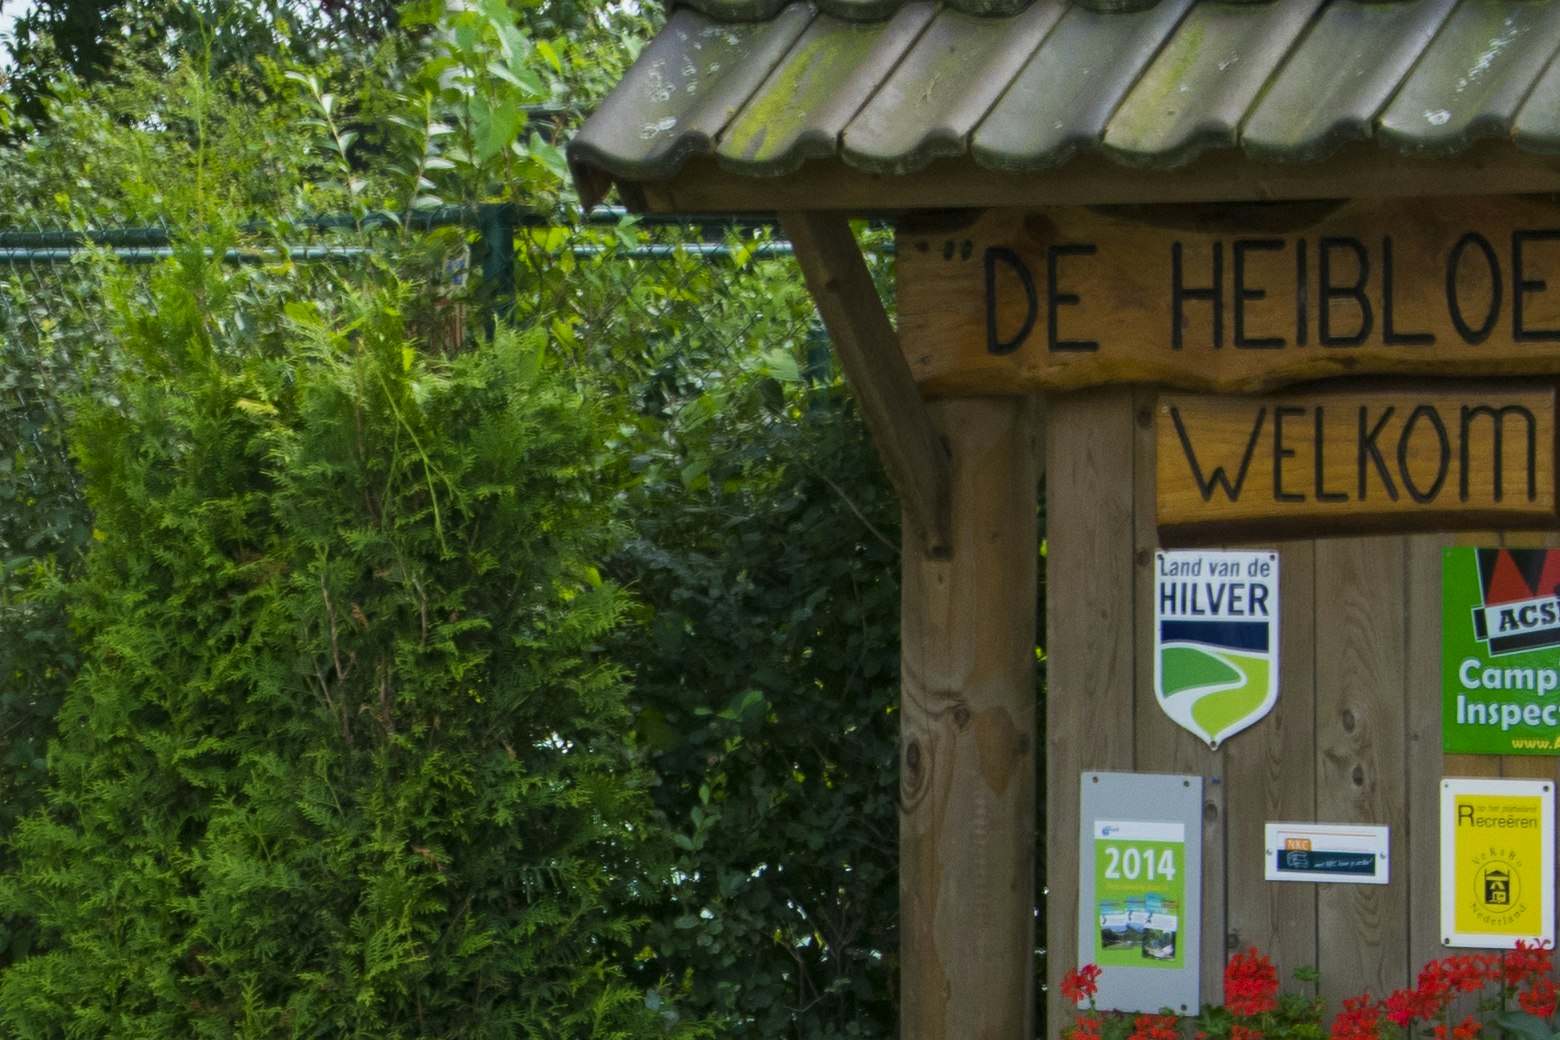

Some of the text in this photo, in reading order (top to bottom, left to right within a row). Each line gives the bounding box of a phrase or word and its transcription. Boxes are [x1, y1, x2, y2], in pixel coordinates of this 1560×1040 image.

[1159, 557, 1271, 577] Land van de
[1160, 582, 1269, 616] HILVER
[1457, 804, 1538, 829] Recreëren
[1104, 847, 1176, 881] 2014
[1469, 902, 1527, 926] Nederland
